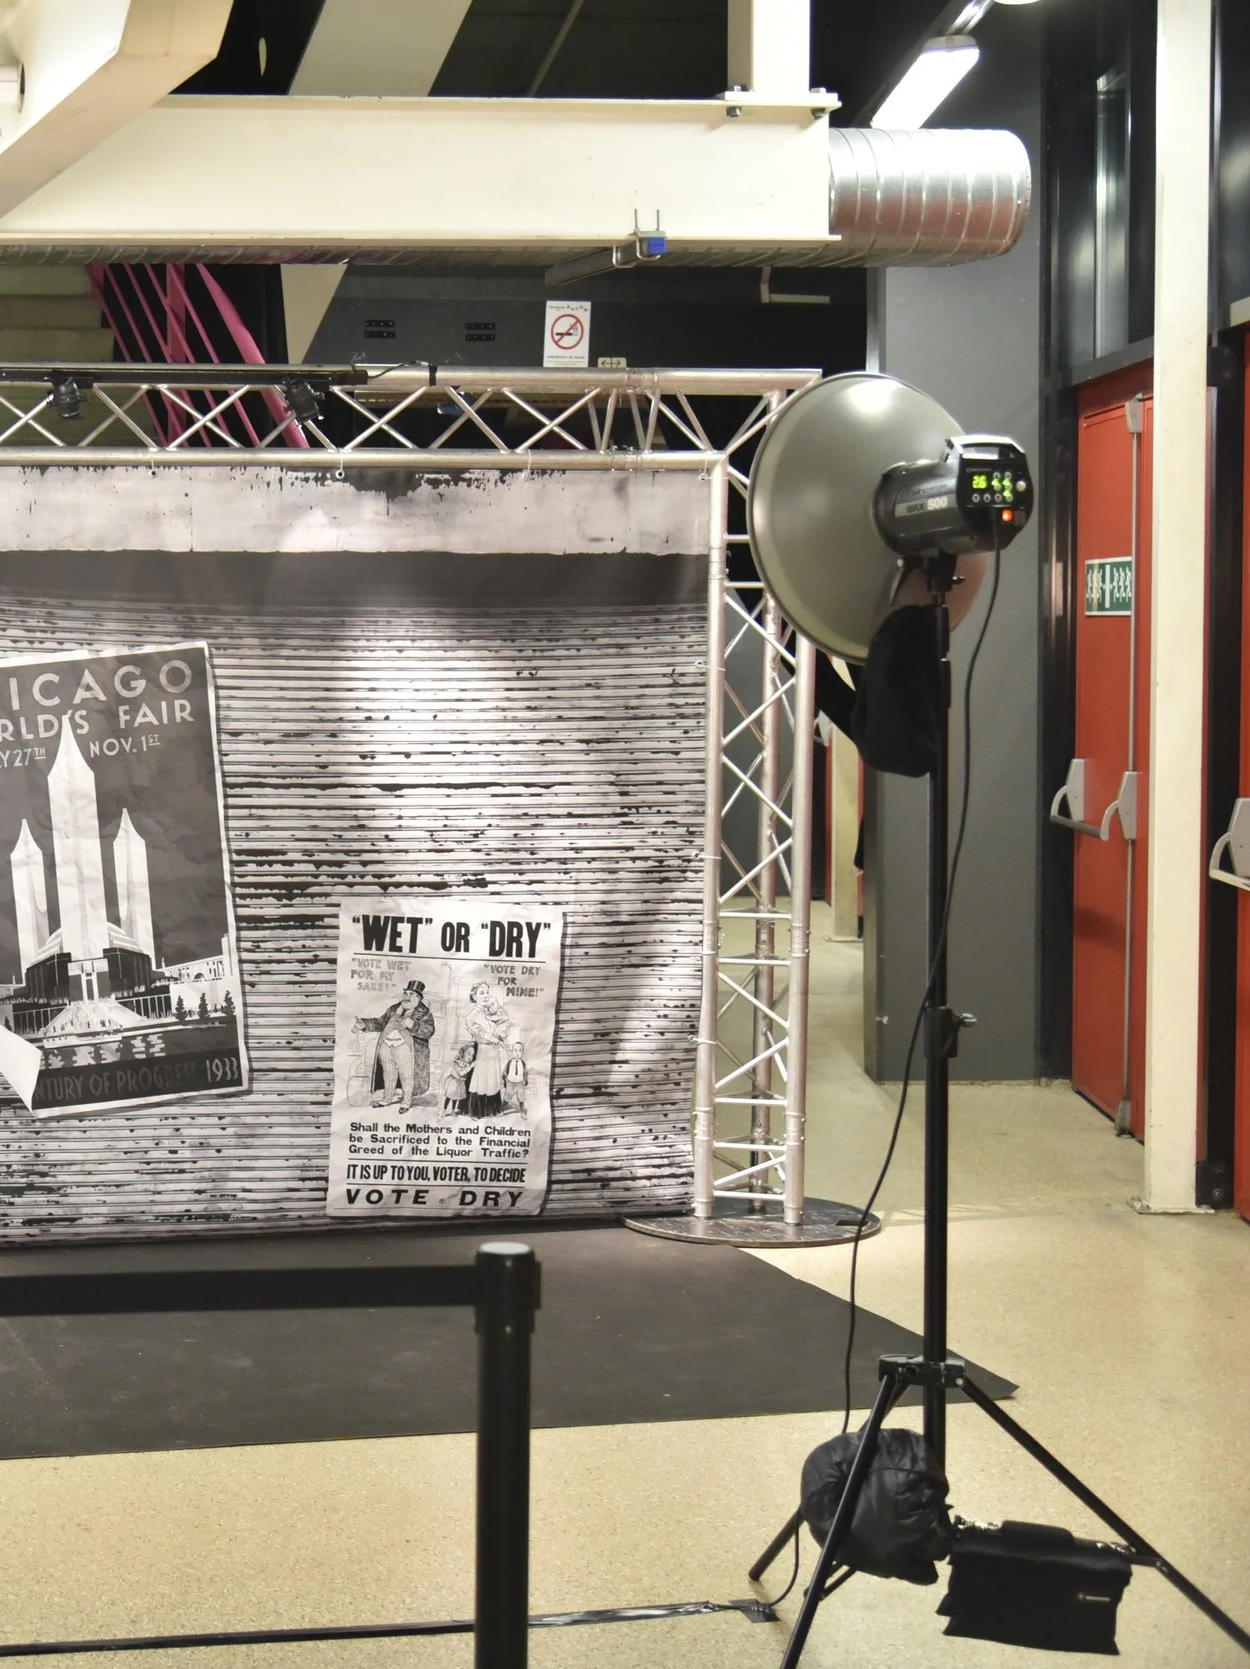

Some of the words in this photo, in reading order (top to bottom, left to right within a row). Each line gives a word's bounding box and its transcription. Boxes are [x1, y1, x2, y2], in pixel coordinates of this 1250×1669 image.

[927, 497, 948, 511] 500
[118, 699, 195, 730] FAIR
[89, 737, 137, 758] NOV.
[141, 734, 161, 752] 1ST
[352, 914, 433, 953] "WET"
[441, 921, 470, 953] OR
[481, 920, 551, 958] "DRY"
[351, 969, 373, 980] FOR
[379, 971, 394, 981] MY
[521, 966, 541, 975] DRY
[497, 976, 517, 985] FOR
[90, 1072, 110, 1097] OF
[206, 1057, 238, 1083] 1933
[350, 1122, 378, 1132] Shall
[383, 1123, 400, 1132] the
[406, 1123, 452, 1134] Mothers
[458, 1125, 479, 1135] and
[484, 1126, 531, 1137] Children
[349, 1133, 363, 1143] be
[370, 1134, 430, 1144] Sacrificed
[437, 1136, 448, 1145] to
[455, 1136, 472, 1145] the
[479, 1136, 530, 1147] Financial
[349, 1144, 384, 1154] Greed
[392, 1145, 403, 1155] of
[411, 1145, 429, 1155] the
[436, 1146, 473, 1158] Liquor
[481, 1147, 529, 1158] Traffic?
[346, 1164, 358, 1179] IT
[360, 1164, 371, 1180] IS
[373, 1164, 388, 1180] UP
[391, 1165, 404, 1181] TO
[406, 1165, 430, 1182] YOU,
[433, 1166, 470, 1183] VOTER,
[474, 1167, 487, 1182] TO
[489, 1168, 526, 1183] DECIDE
[346, 1188, 429, 1205] VOTE
[459, 1190, 523, 1207] DRY
